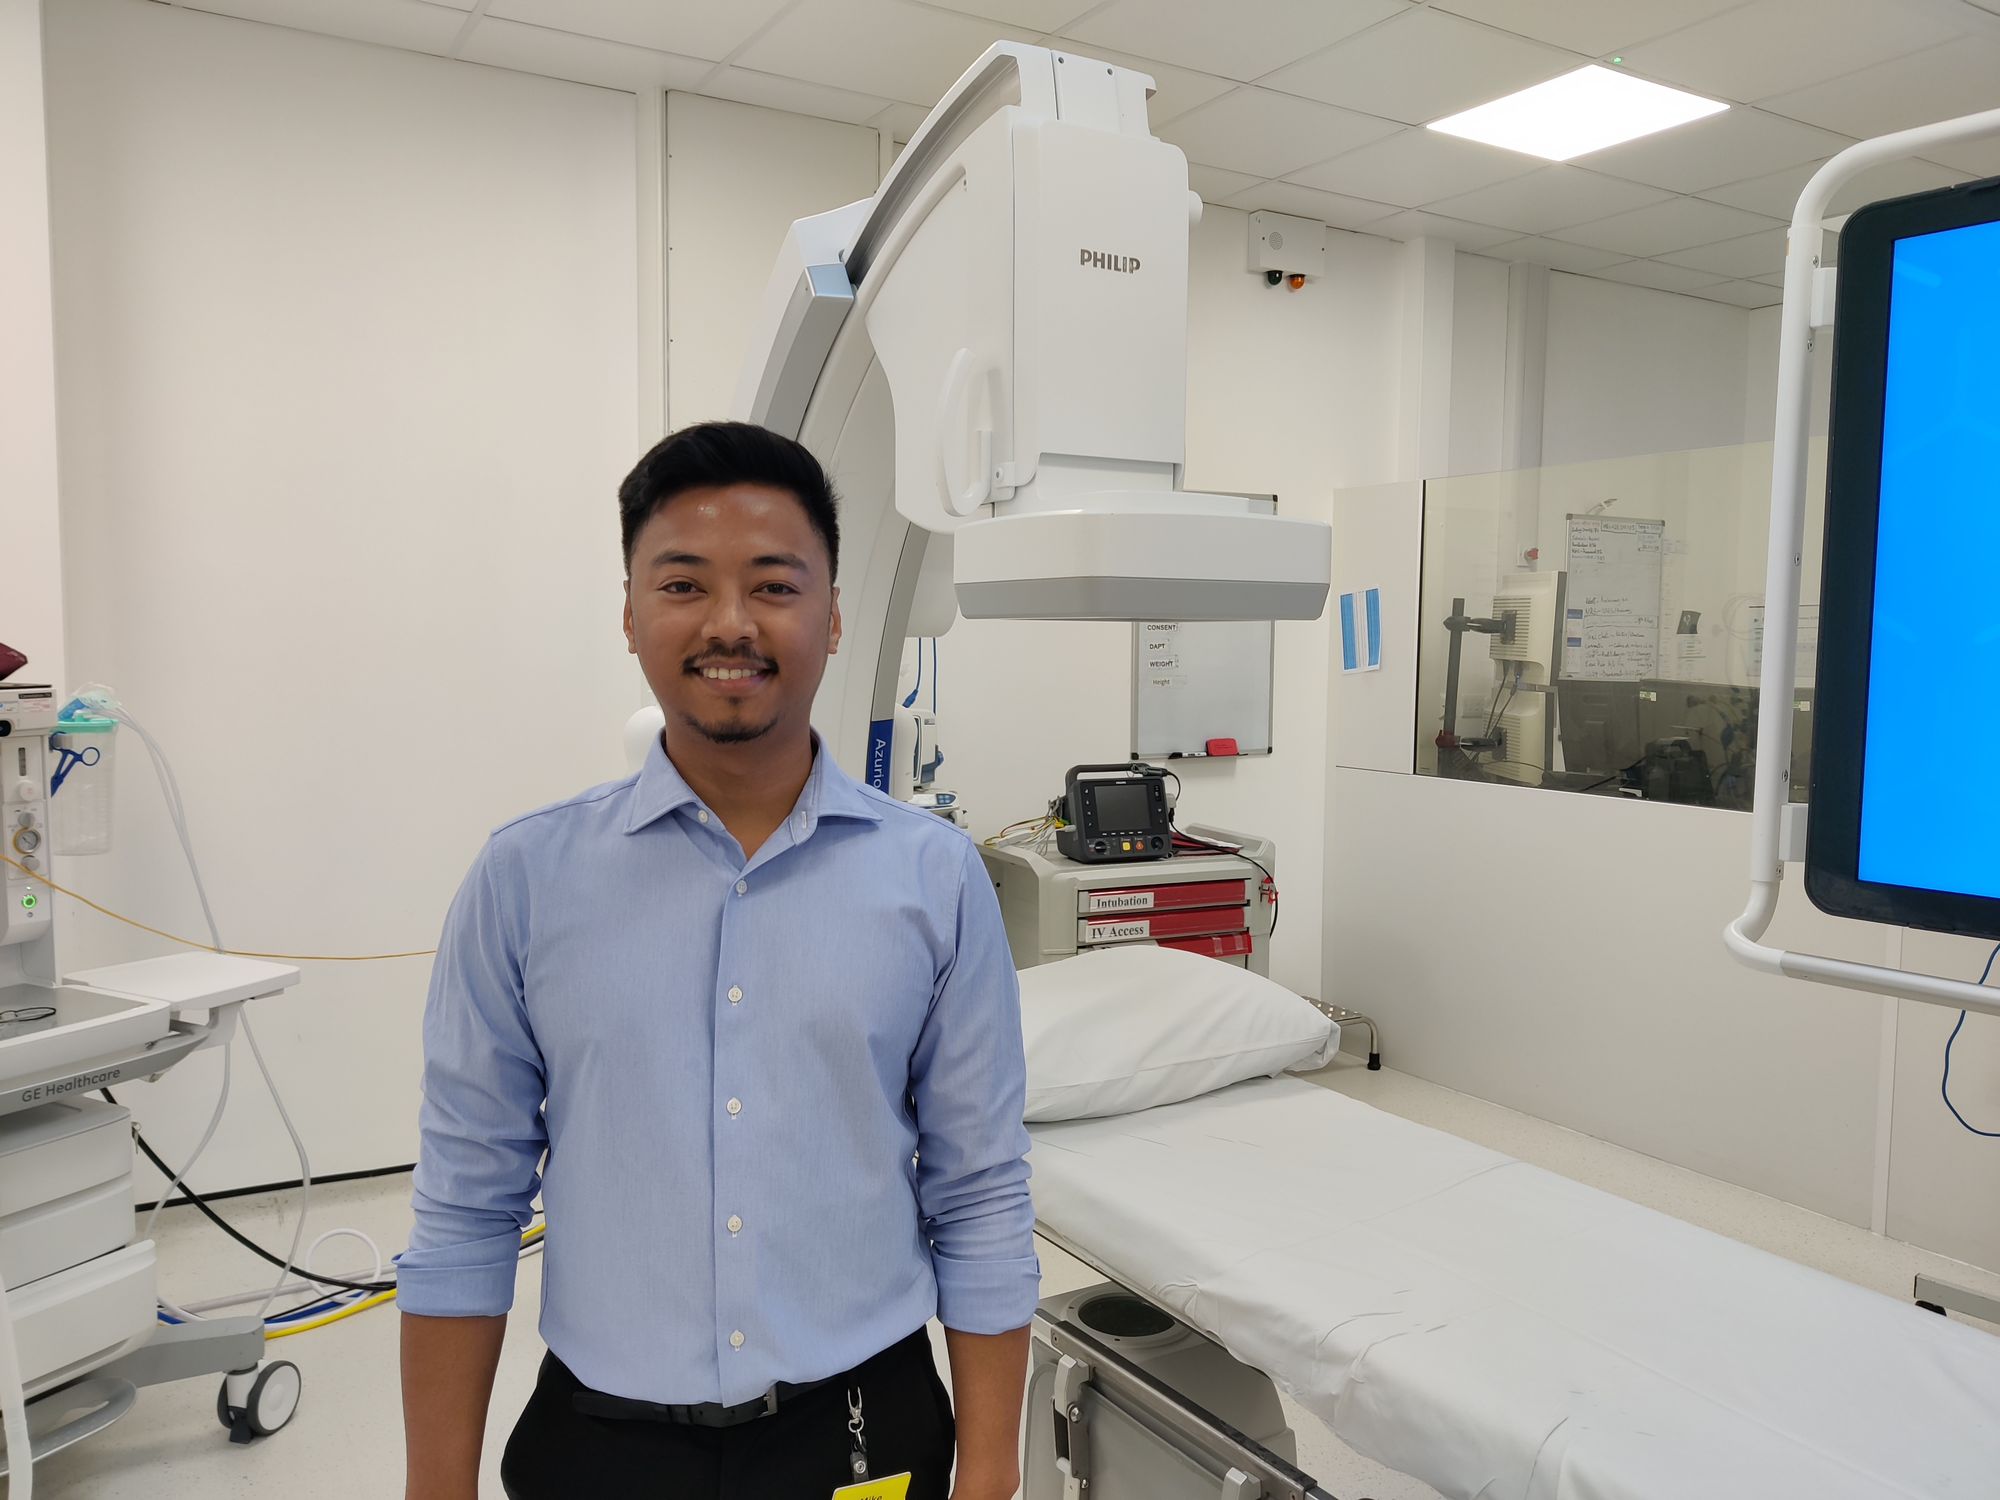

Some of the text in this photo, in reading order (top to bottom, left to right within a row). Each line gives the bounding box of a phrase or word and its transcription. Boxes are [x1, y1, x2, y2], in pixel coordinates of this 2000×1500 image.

[1080, 249, 1141, 274] PHILIP
[873, 739, 886, 789] Azurio
[1097, 896, 1148, 908] Intubation
[1092, 926, 1144, 939] IV Access
[22, 1069, 120, 1102] GE Healthcare
